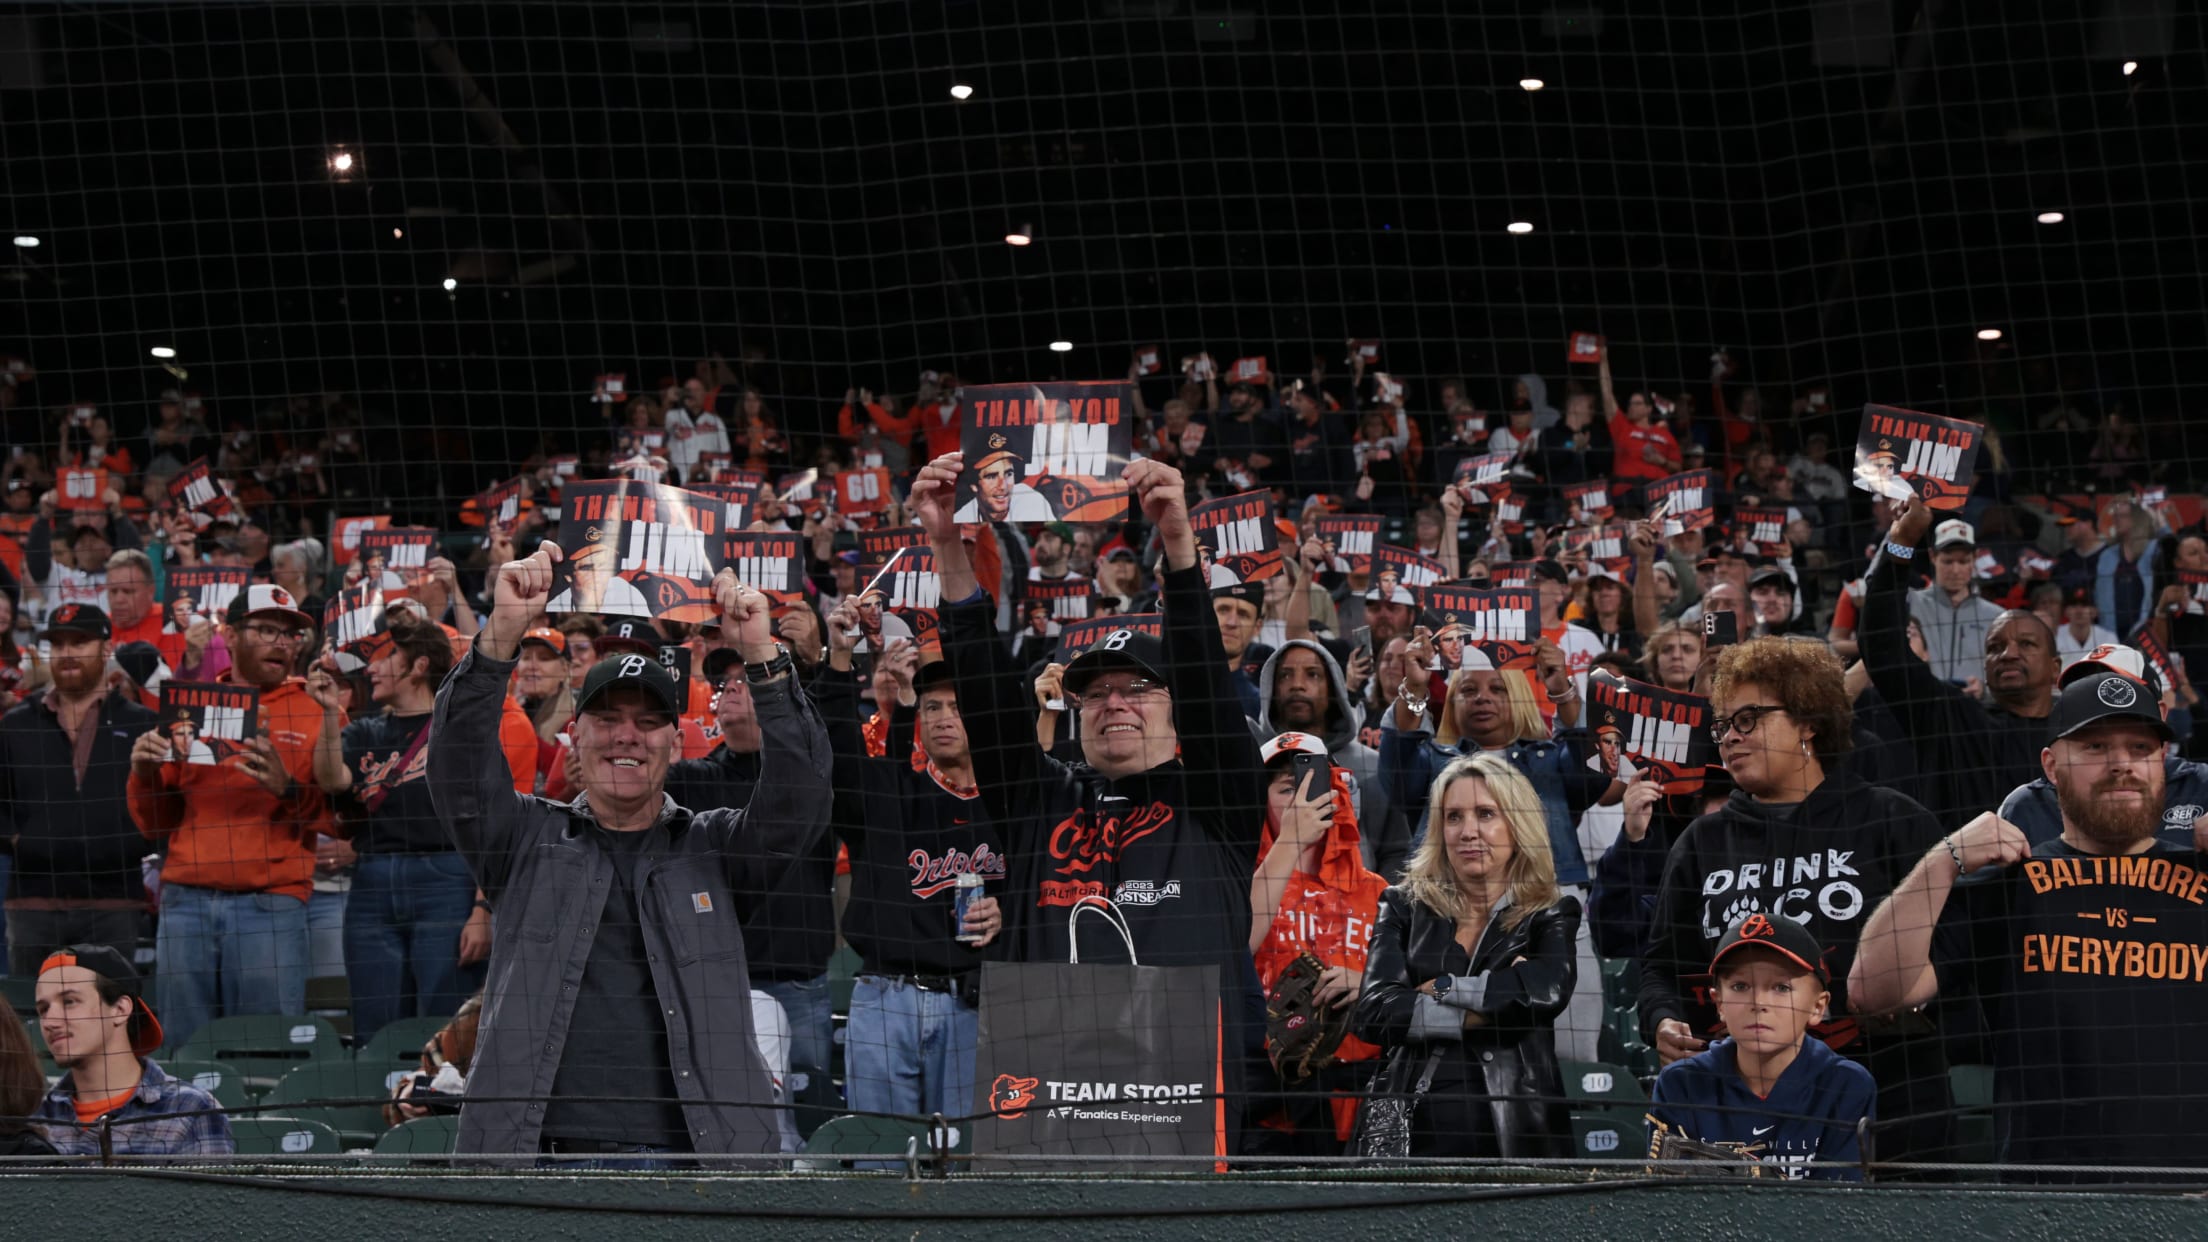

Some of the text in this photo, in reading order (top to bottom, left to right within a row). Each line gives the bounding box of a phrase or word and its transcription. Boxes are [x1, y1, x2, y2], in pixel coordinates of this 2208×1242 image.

[974, 398, 1120, 427] THANK YOU
[1871, 414, 1973, 450] THANK YOU
[1024, 422, 1109, 476] JIM
[1901, 438, 1962, 482] JIM
[846, 473, 880, 503] 60
[1235, 499, 1267, 518] YOU
[1667, 486, 1703, 516] JIM
[673, 505, 715, 535] OU
[365, 534, 433, 548] THANK YOU
[621, 519, 705, 580] JIM
[723, 541, 796, 559] ANK YOU
[864, 534, 911, 552] THANK
[1215, 515, 1265, 560] JIM
[1337, 530, 1374, 554] JIM
[388, 543, 427, 568] JIM
[1379, 548, 1418, 565] THANK
[171, 571, 247, 588] THANK YOU
[889, 570, 941, 608] JIM
[1028, 584, 1091, 598] THANK YOU
[1051, 595, 1088, 619] JIM
[1433, 593, 1533, 612] THANK YOU
[1471, 608, 1526, 641] JIM
[1103, 629, 1133, 651] B
[618, 655, 646, 679] B
[167, 688, 252, 711] THANK YOU
[1594, 681, 1702, 728] THANK YOU
[198, 704, 244, 742] JIM
[1625, 713, 1692, 764] JIM
[1702, 848, 1860, 896] DRINK
[2023, 856, 2208, 906] BALTIMORE
[1125, 881, 1154, 891] 2023
[2023, 933, 2208, 983] EVERYBODY
[1046, 1080, 1204, 1105] TEAM STORE
[1590, 1076, 1608, 1089] 10
[1047, 1108, 1182, 1124] A Fanatics Experience
[1593, 1135, 1612, 1149] 10
